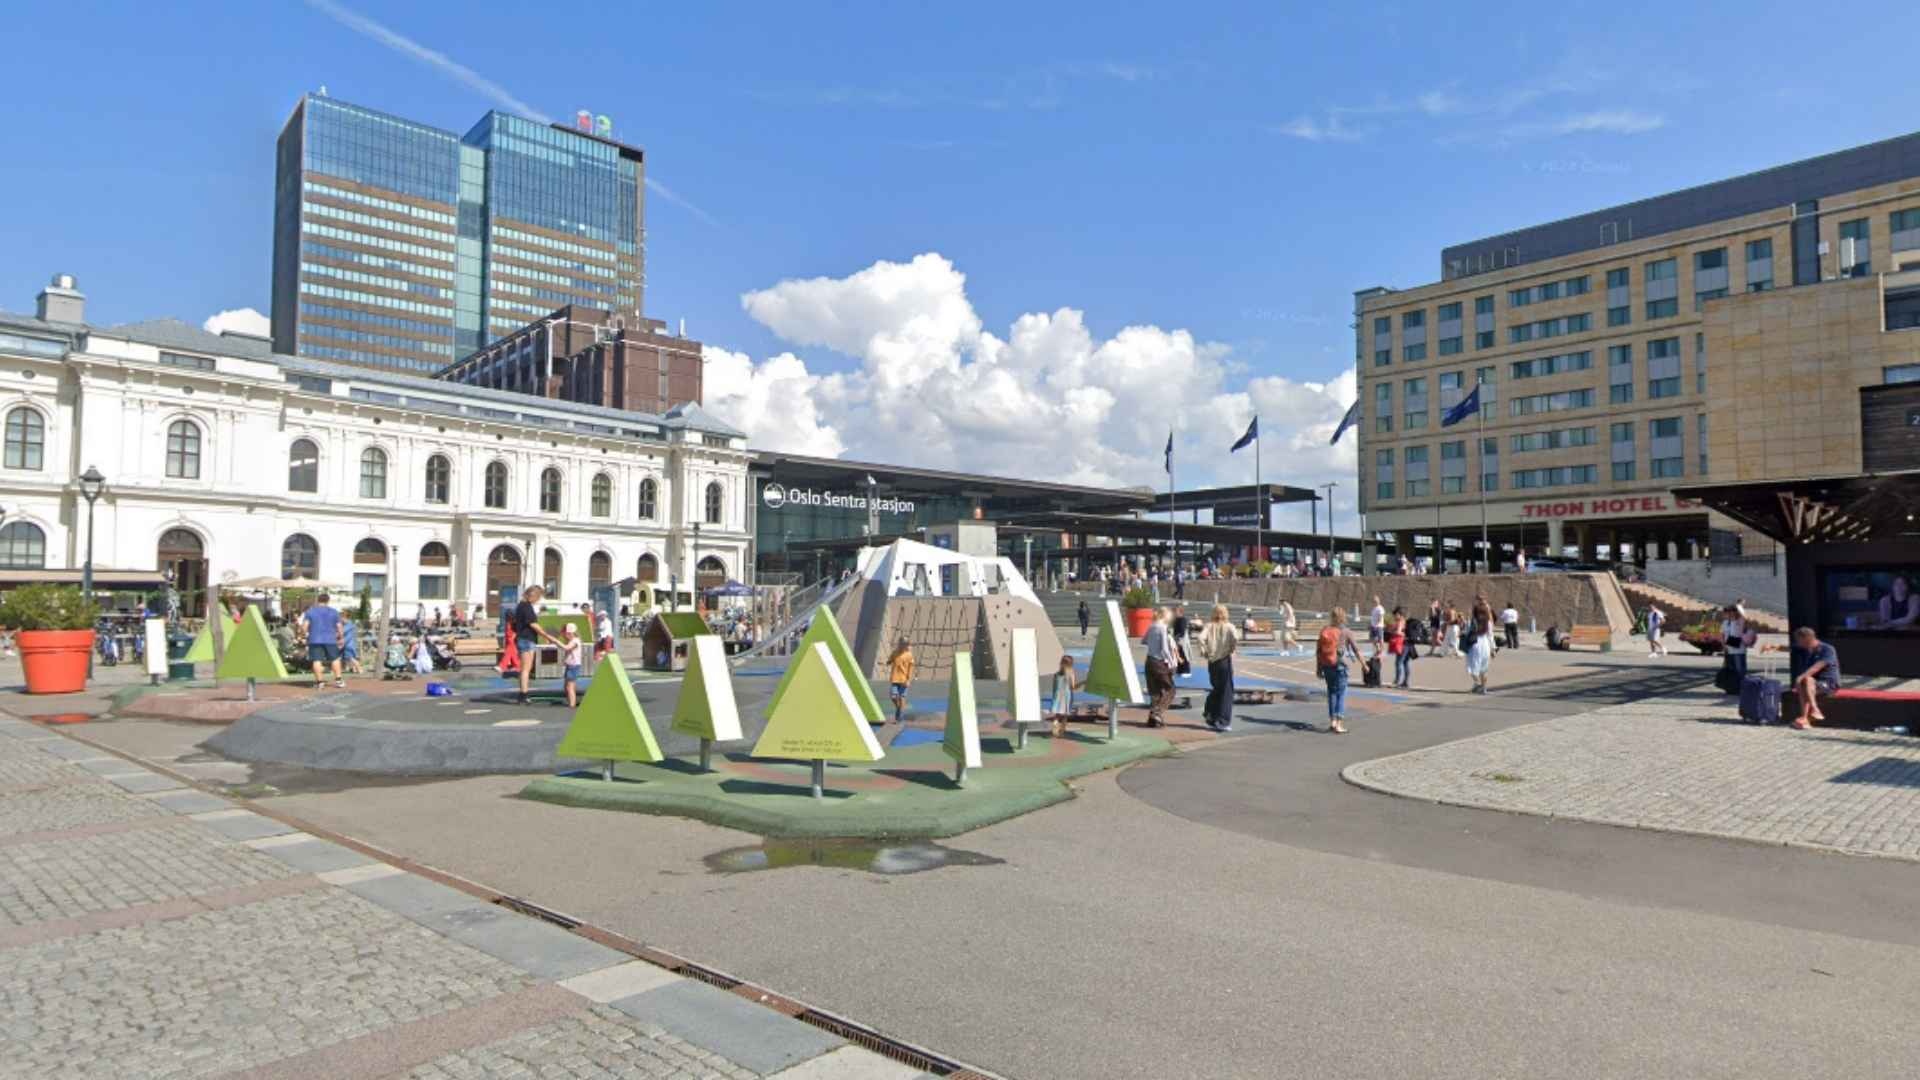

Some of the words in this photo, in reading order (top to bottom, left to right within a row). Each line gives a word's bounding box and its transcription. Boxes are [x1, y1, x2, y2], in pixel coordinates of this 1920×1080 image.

[789, 488, 821, 505] Oslo
[824, 490, 915, 515] Sentrastasjon
[1523, 502, 1584, 518] THON
[1592, 496, 1668, 514] HOTEL
